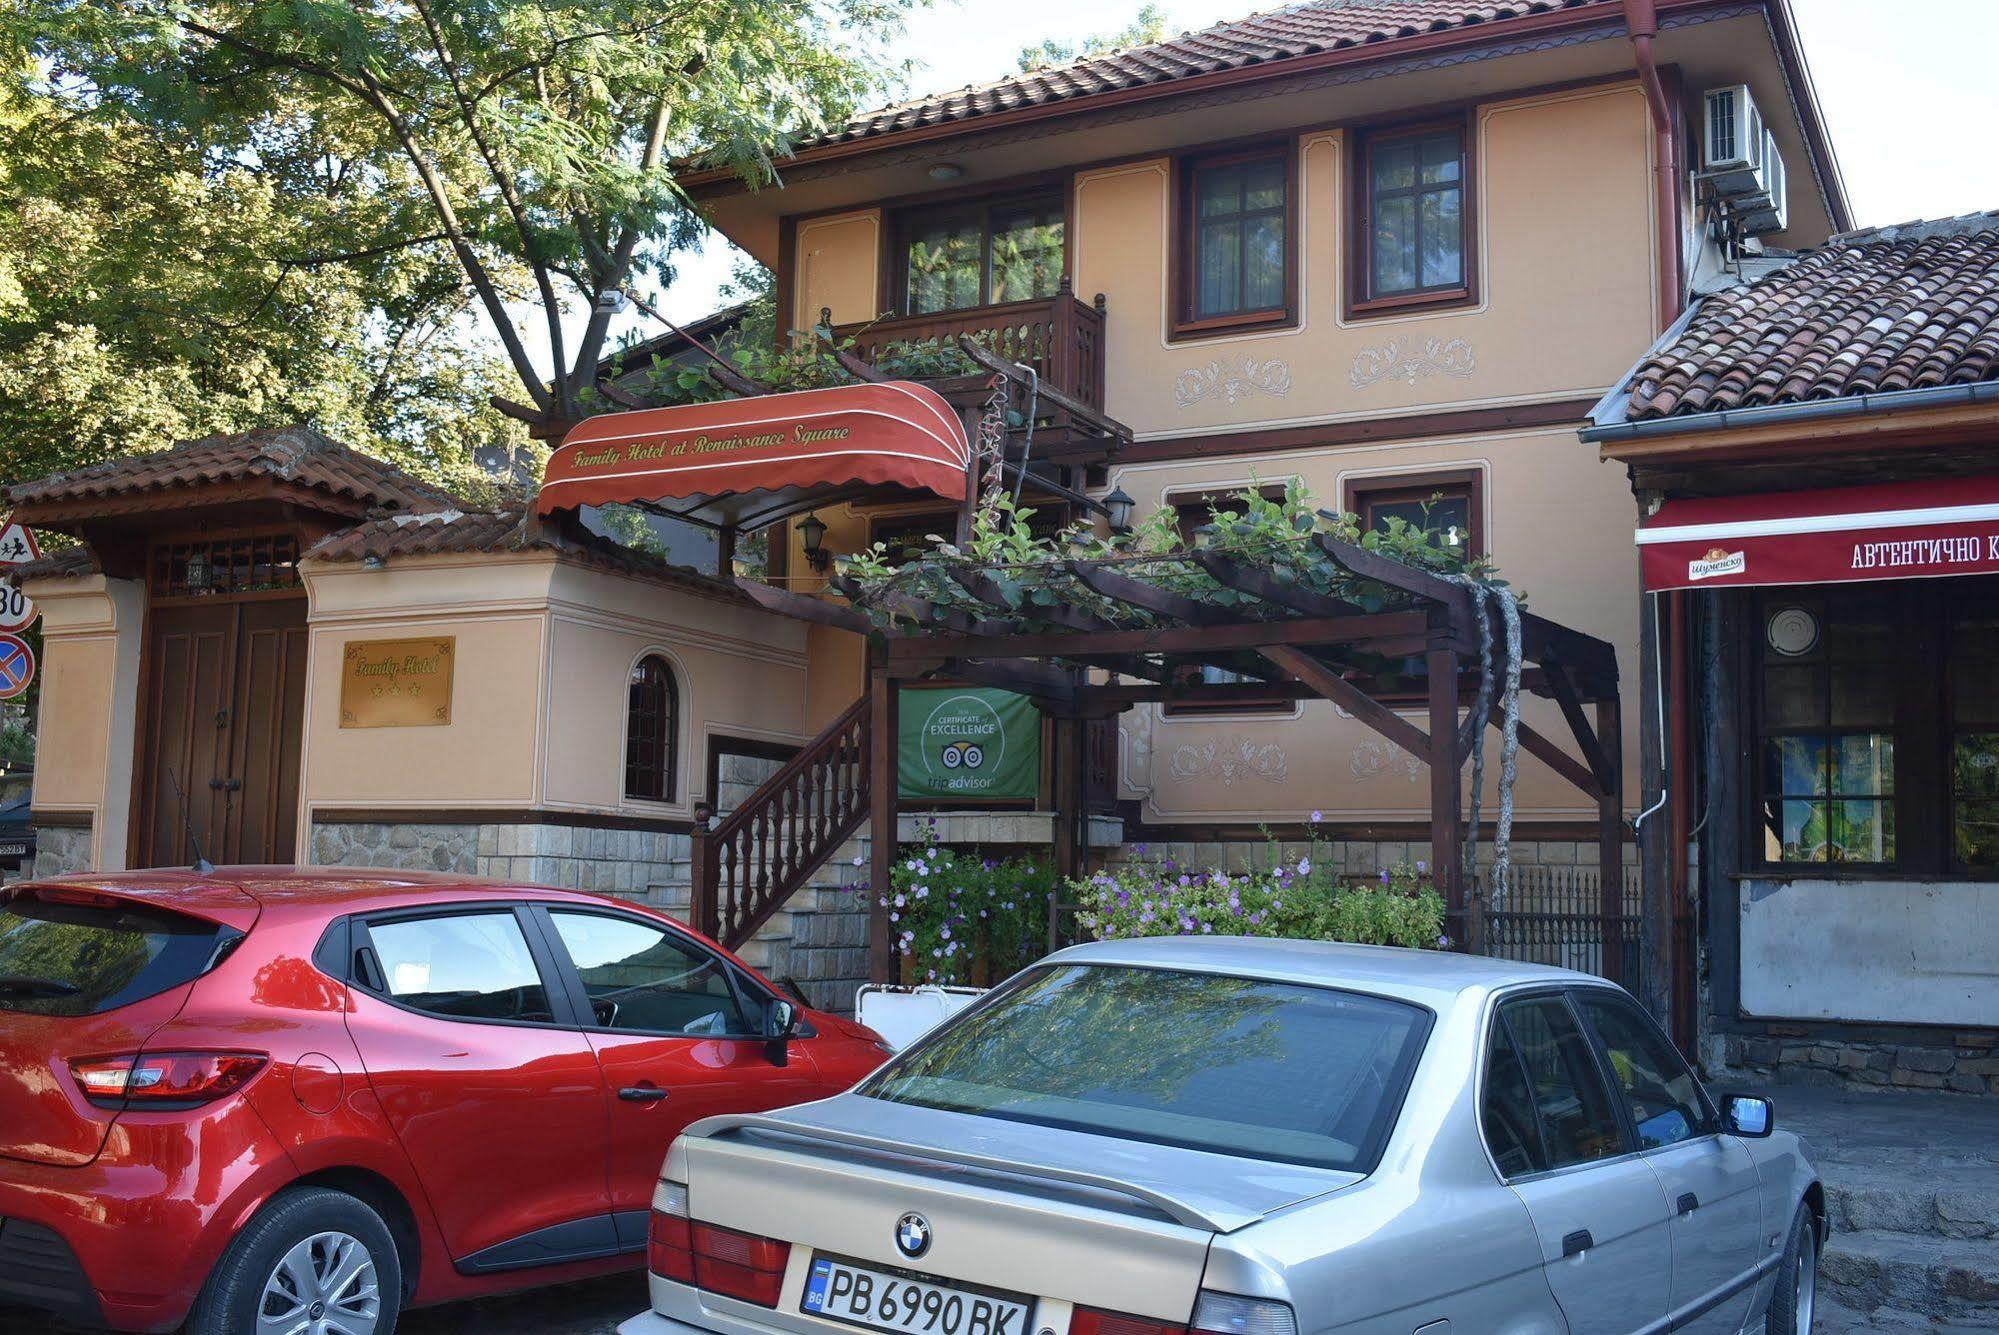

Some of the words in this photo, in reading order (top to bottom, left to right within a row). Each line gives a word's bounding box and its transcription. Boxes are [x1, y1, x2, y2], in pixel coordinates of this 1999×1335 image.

[571, 449, 620, 468] Family
[624, 440, 668, 461] Hotel
[671, 441, 686, 456] at
[691, 433, 785, 455] Renaissance
[791, 424, 849, 446] Square
[1851, 536, 1980, 569] АВТЕНТИЧНО
[355, 656, 399, 680] Family
[402, 655, 440, 675] Hotel
[938, 715, 980, 725] CERTIFICATE
[930, 724, 995, 736] EXCELLENCE
[808, 1291, 824, 1305] BG
